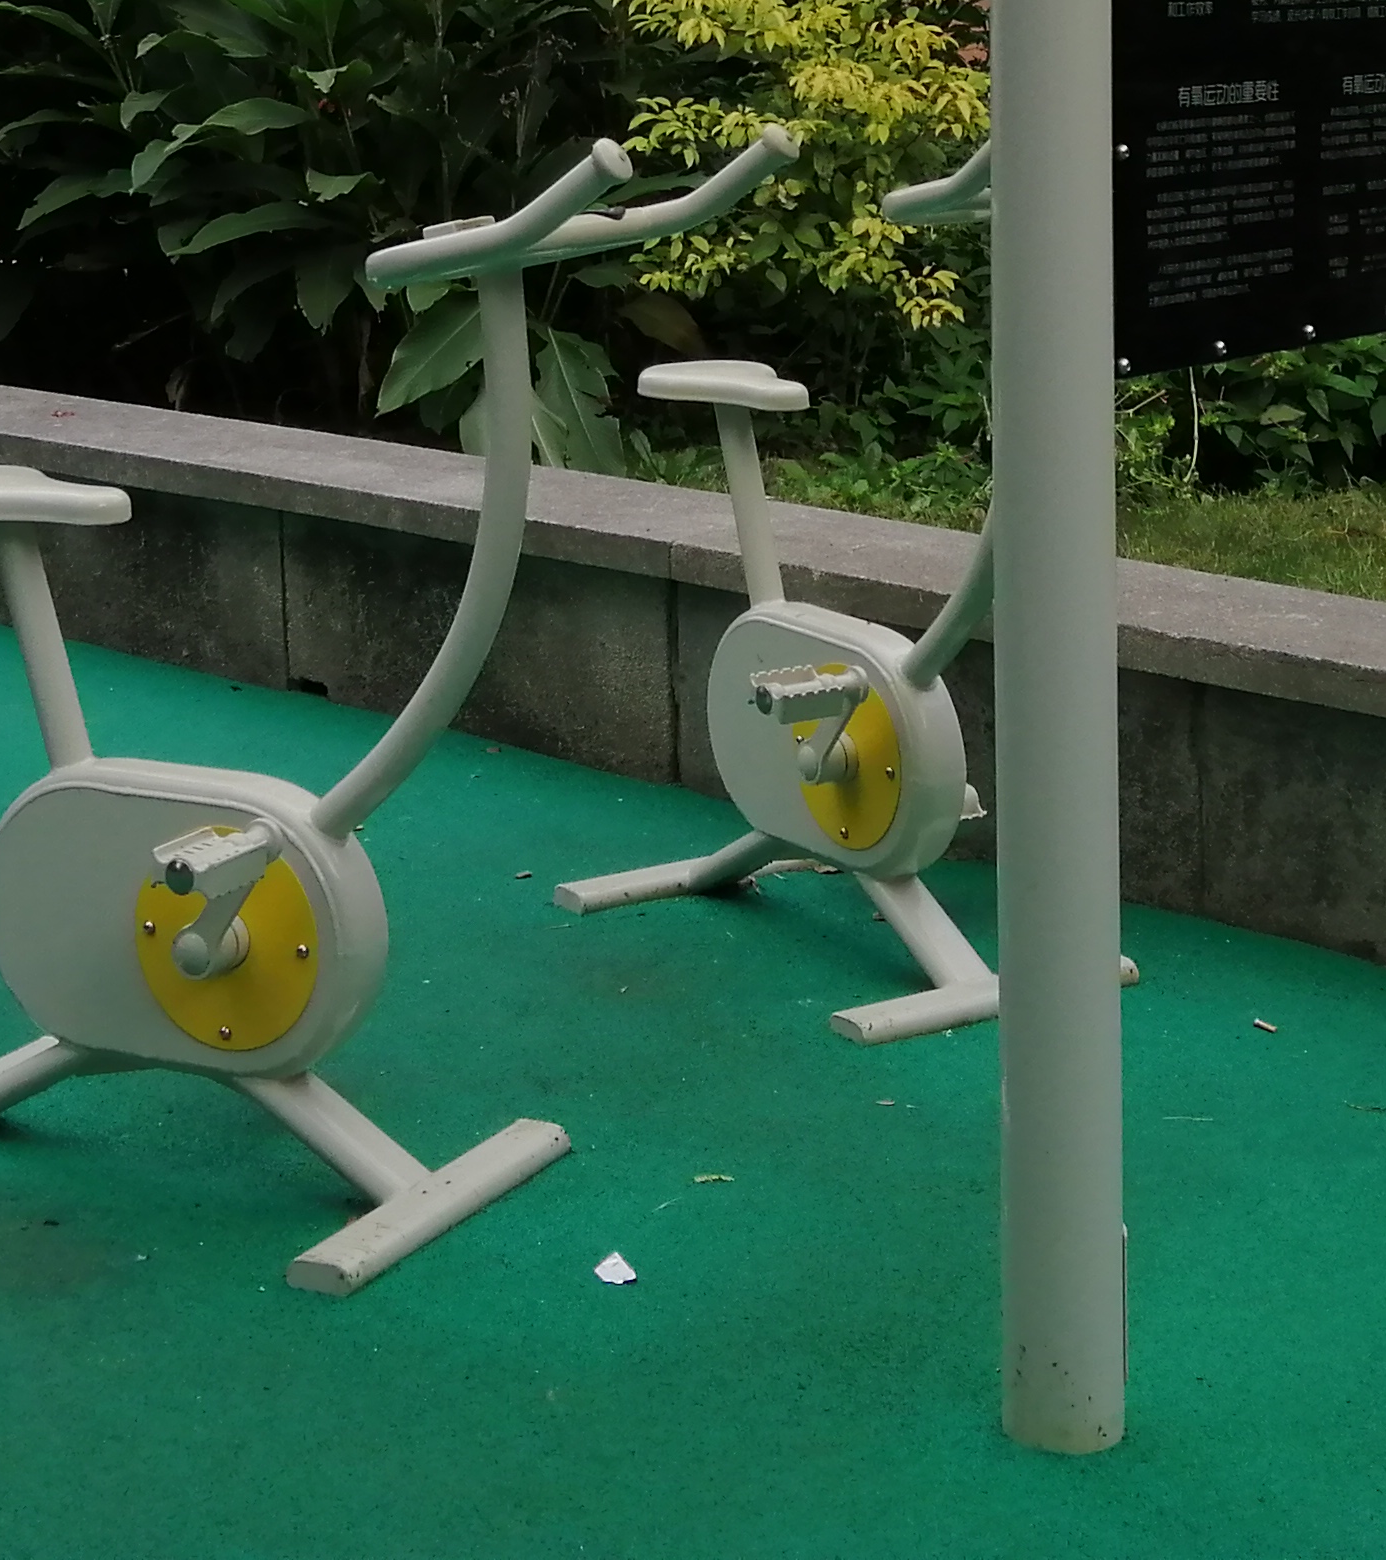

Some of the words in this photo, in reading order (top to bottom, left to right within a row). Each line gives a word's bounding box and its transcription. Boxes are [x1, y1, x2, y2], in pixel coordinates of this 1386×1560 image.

[1177, 79, 1280, 108] 有氧运动的重要性
